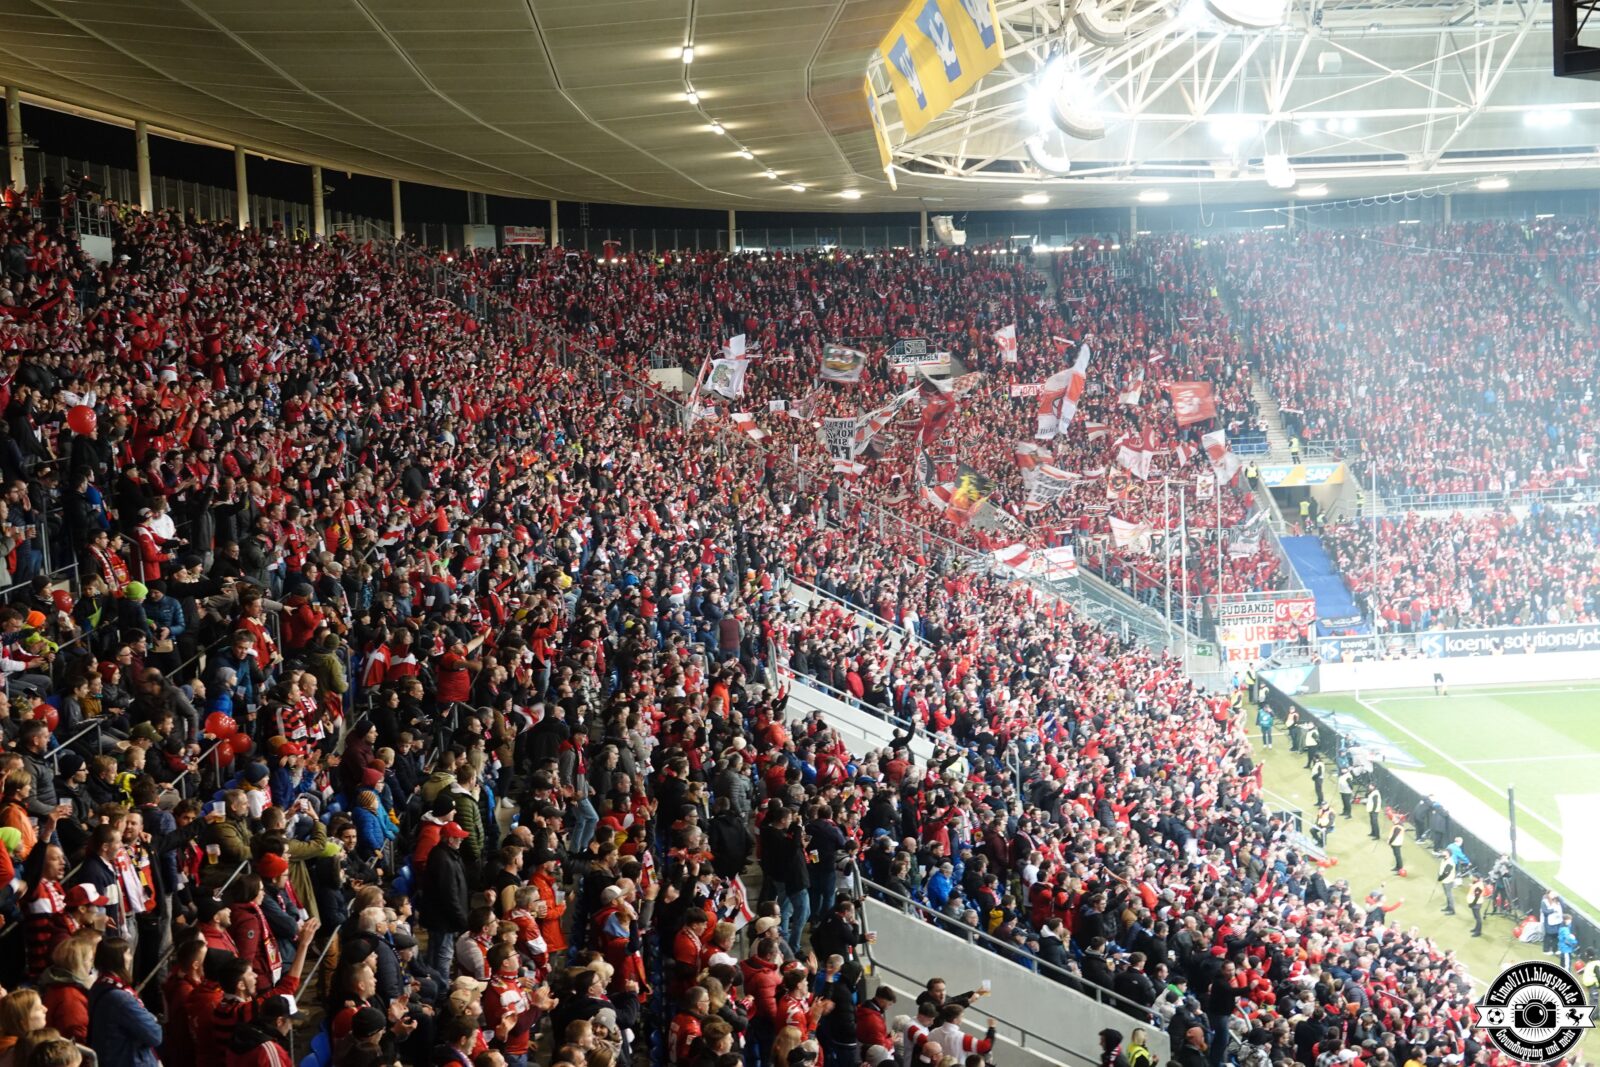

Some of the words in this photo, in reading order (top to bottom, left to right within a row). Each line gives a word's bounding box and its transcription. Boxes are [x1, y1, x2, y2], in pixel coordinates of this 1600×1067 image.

[1262, 469, 1287, 483] SAP
[1306, 467, 1332, 480] SAP
[1221, 616, 1274, 626] STUTTGART
[1228, 646, 1260, 661] RH
